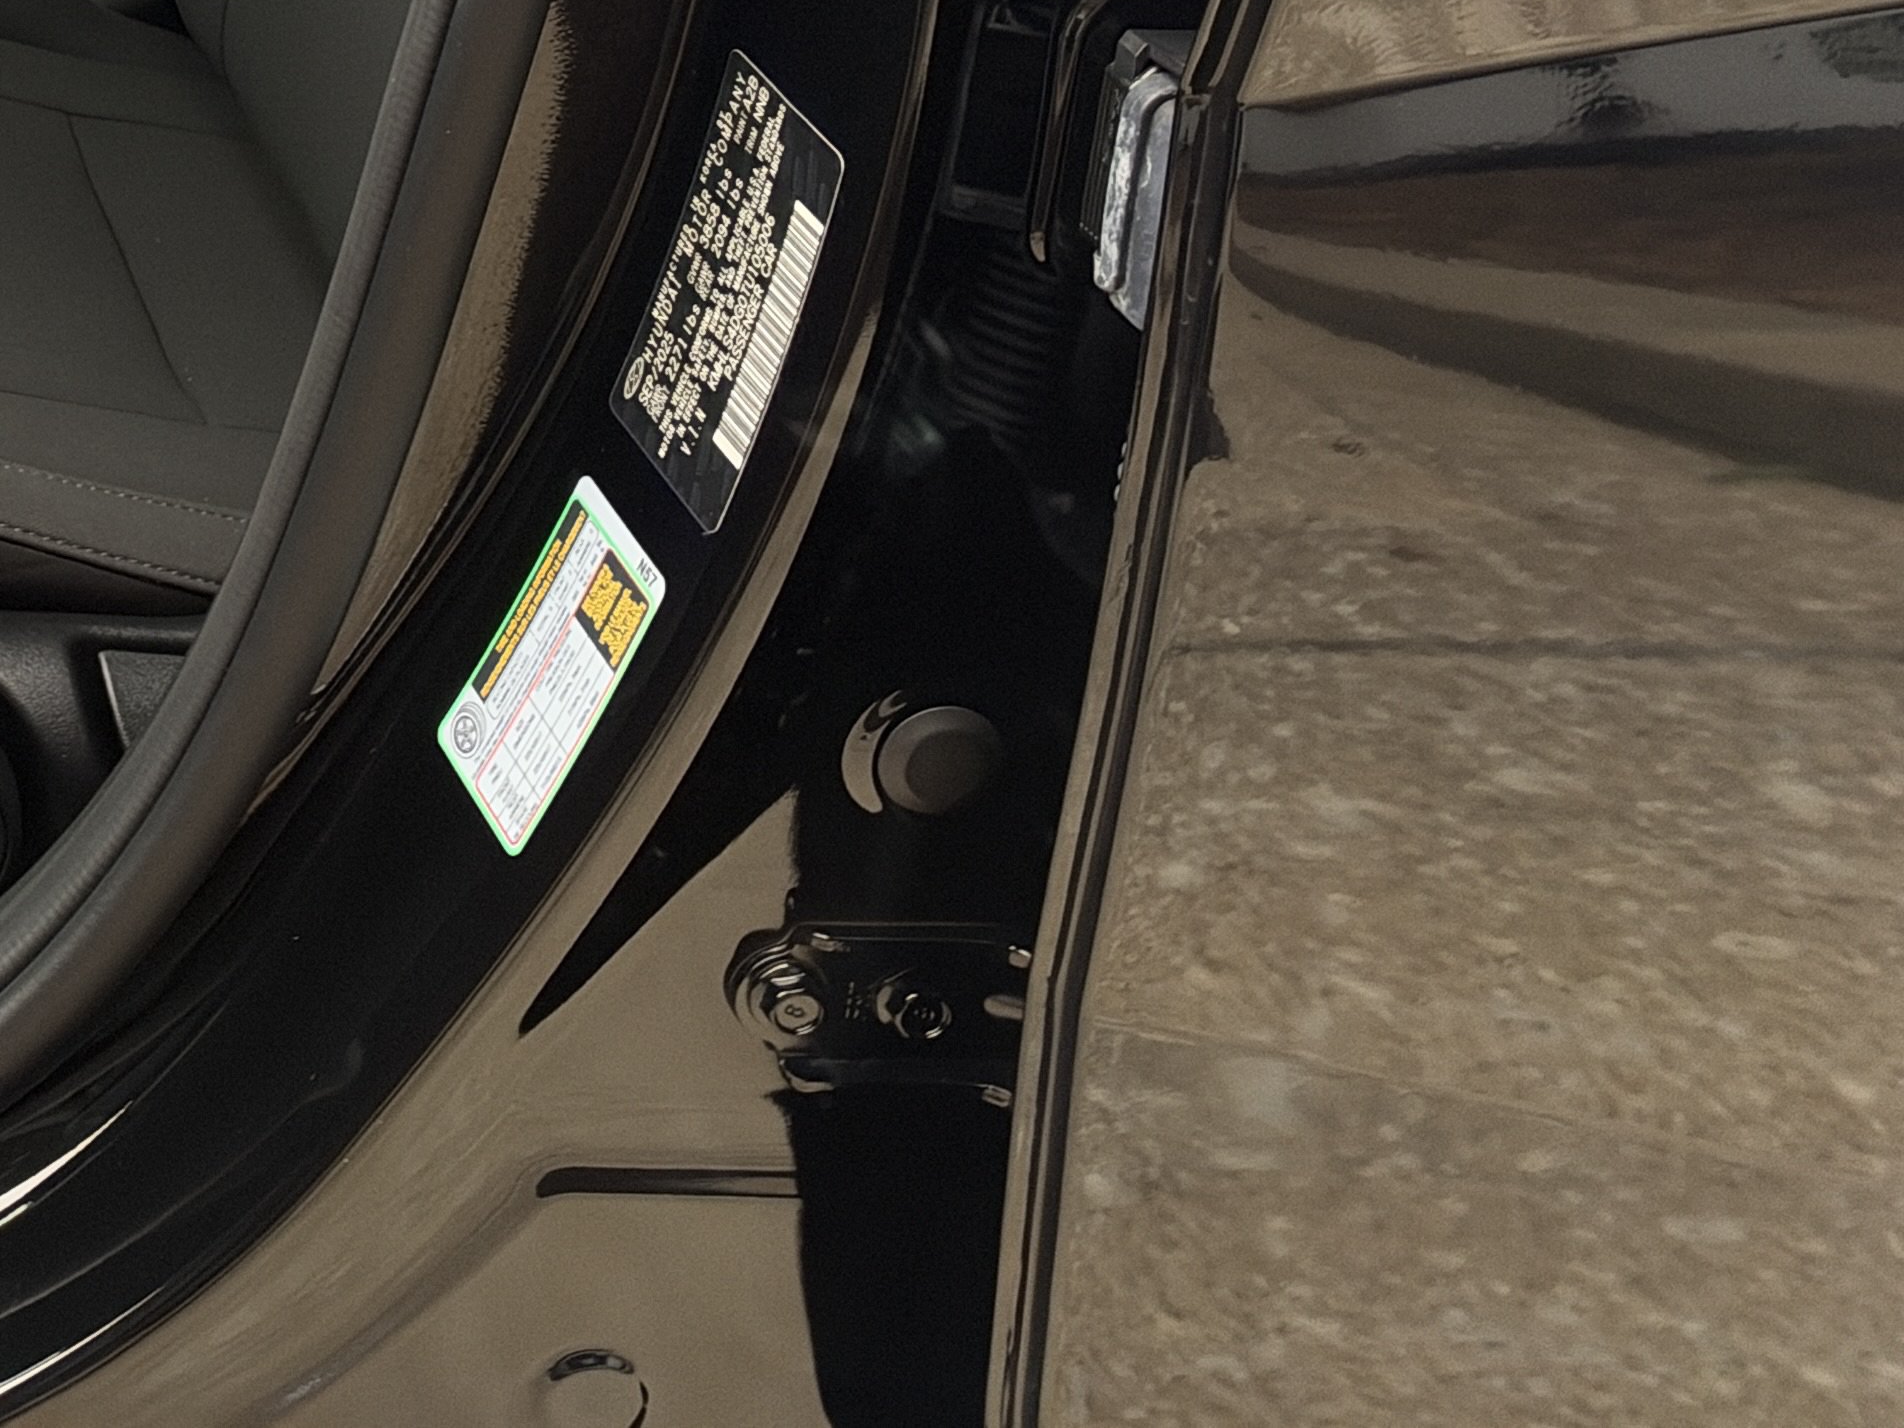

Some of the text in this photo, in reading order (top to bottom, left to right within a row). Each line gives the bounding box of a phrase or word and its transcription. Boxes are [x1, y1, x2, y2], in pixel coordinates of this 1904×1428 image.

[742, 75, 758, 112] A2B
[753, 87, 769, 122] NNB
[643, 73, 750, 363] HYUNDAI MOTOR COMPANY
[699, 203, 720, 248] 3858
[716, 168, 732, 198] lbs
[711, 215, 730, 258] 2094
[727, 178, 743, 209] lbs
[665, 338, 687, 381] 2271
[683, 304, 700, 334] lbs
[724, 243, 777, 380] PASSENGER CAR
[639, 325, 673, 411] SEP/2025
[635, 557, 659, 588] N57
